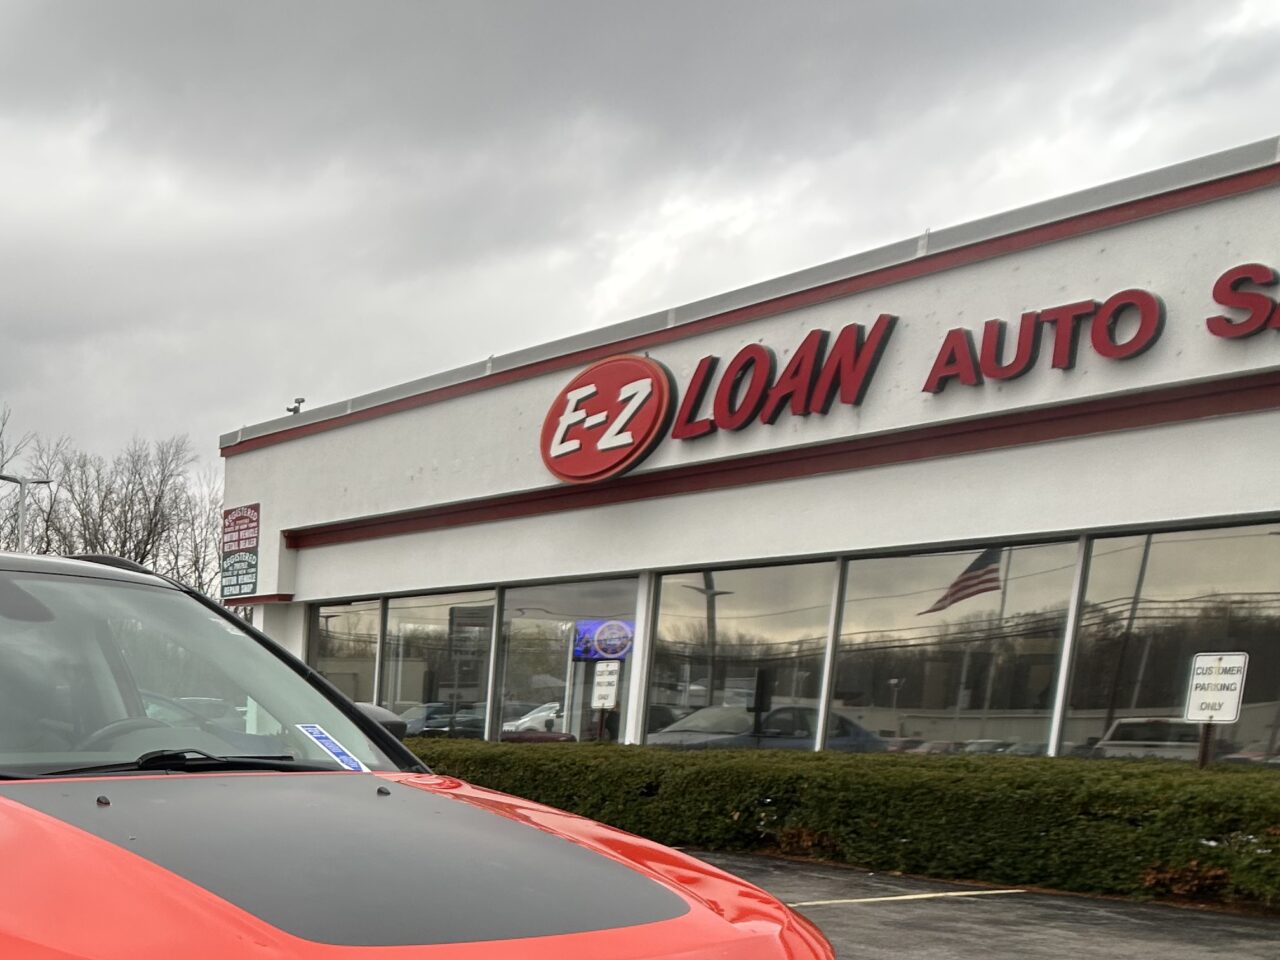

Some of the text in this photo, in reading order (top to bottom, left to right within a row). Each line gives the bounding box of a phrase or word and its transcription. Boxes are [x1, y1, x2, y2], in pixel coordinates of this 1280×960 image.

[549, 262, 1280, 459] E-Z LOAN AUTO S
[1195, 666, 1243, 676] CUSTOMER
[1194, 682, 1238, 692] PARKING
[1200, 701, 1224, 712] ONLY
